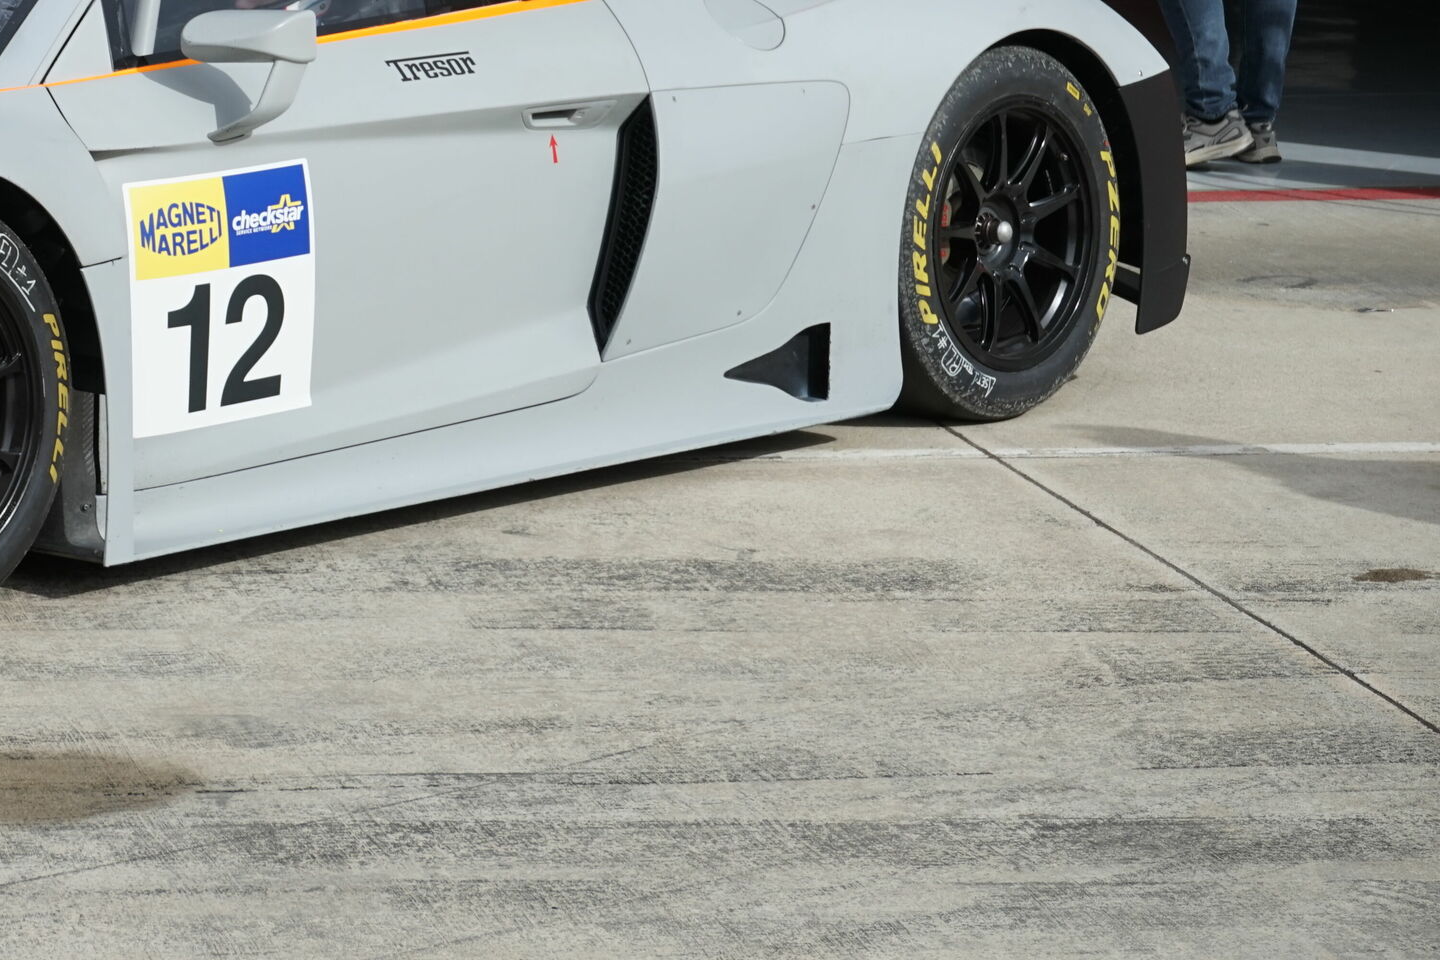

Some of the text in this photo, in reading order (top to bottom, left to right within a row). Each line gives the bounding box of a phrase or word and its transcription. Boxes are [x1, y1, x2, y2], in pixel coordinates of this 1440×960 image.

[385, 51, 476, 82] Tresor
[140, 202, 222, 240] MAGNETI
[232, 205, 304, 231] checkstar
[912, 142, 942, 325] PIRELLI
[1096, 150, 1119, 321] P ZERO
[42, 313, 70, 484] PIRELLI
[167, 274, 285, 413] 12
